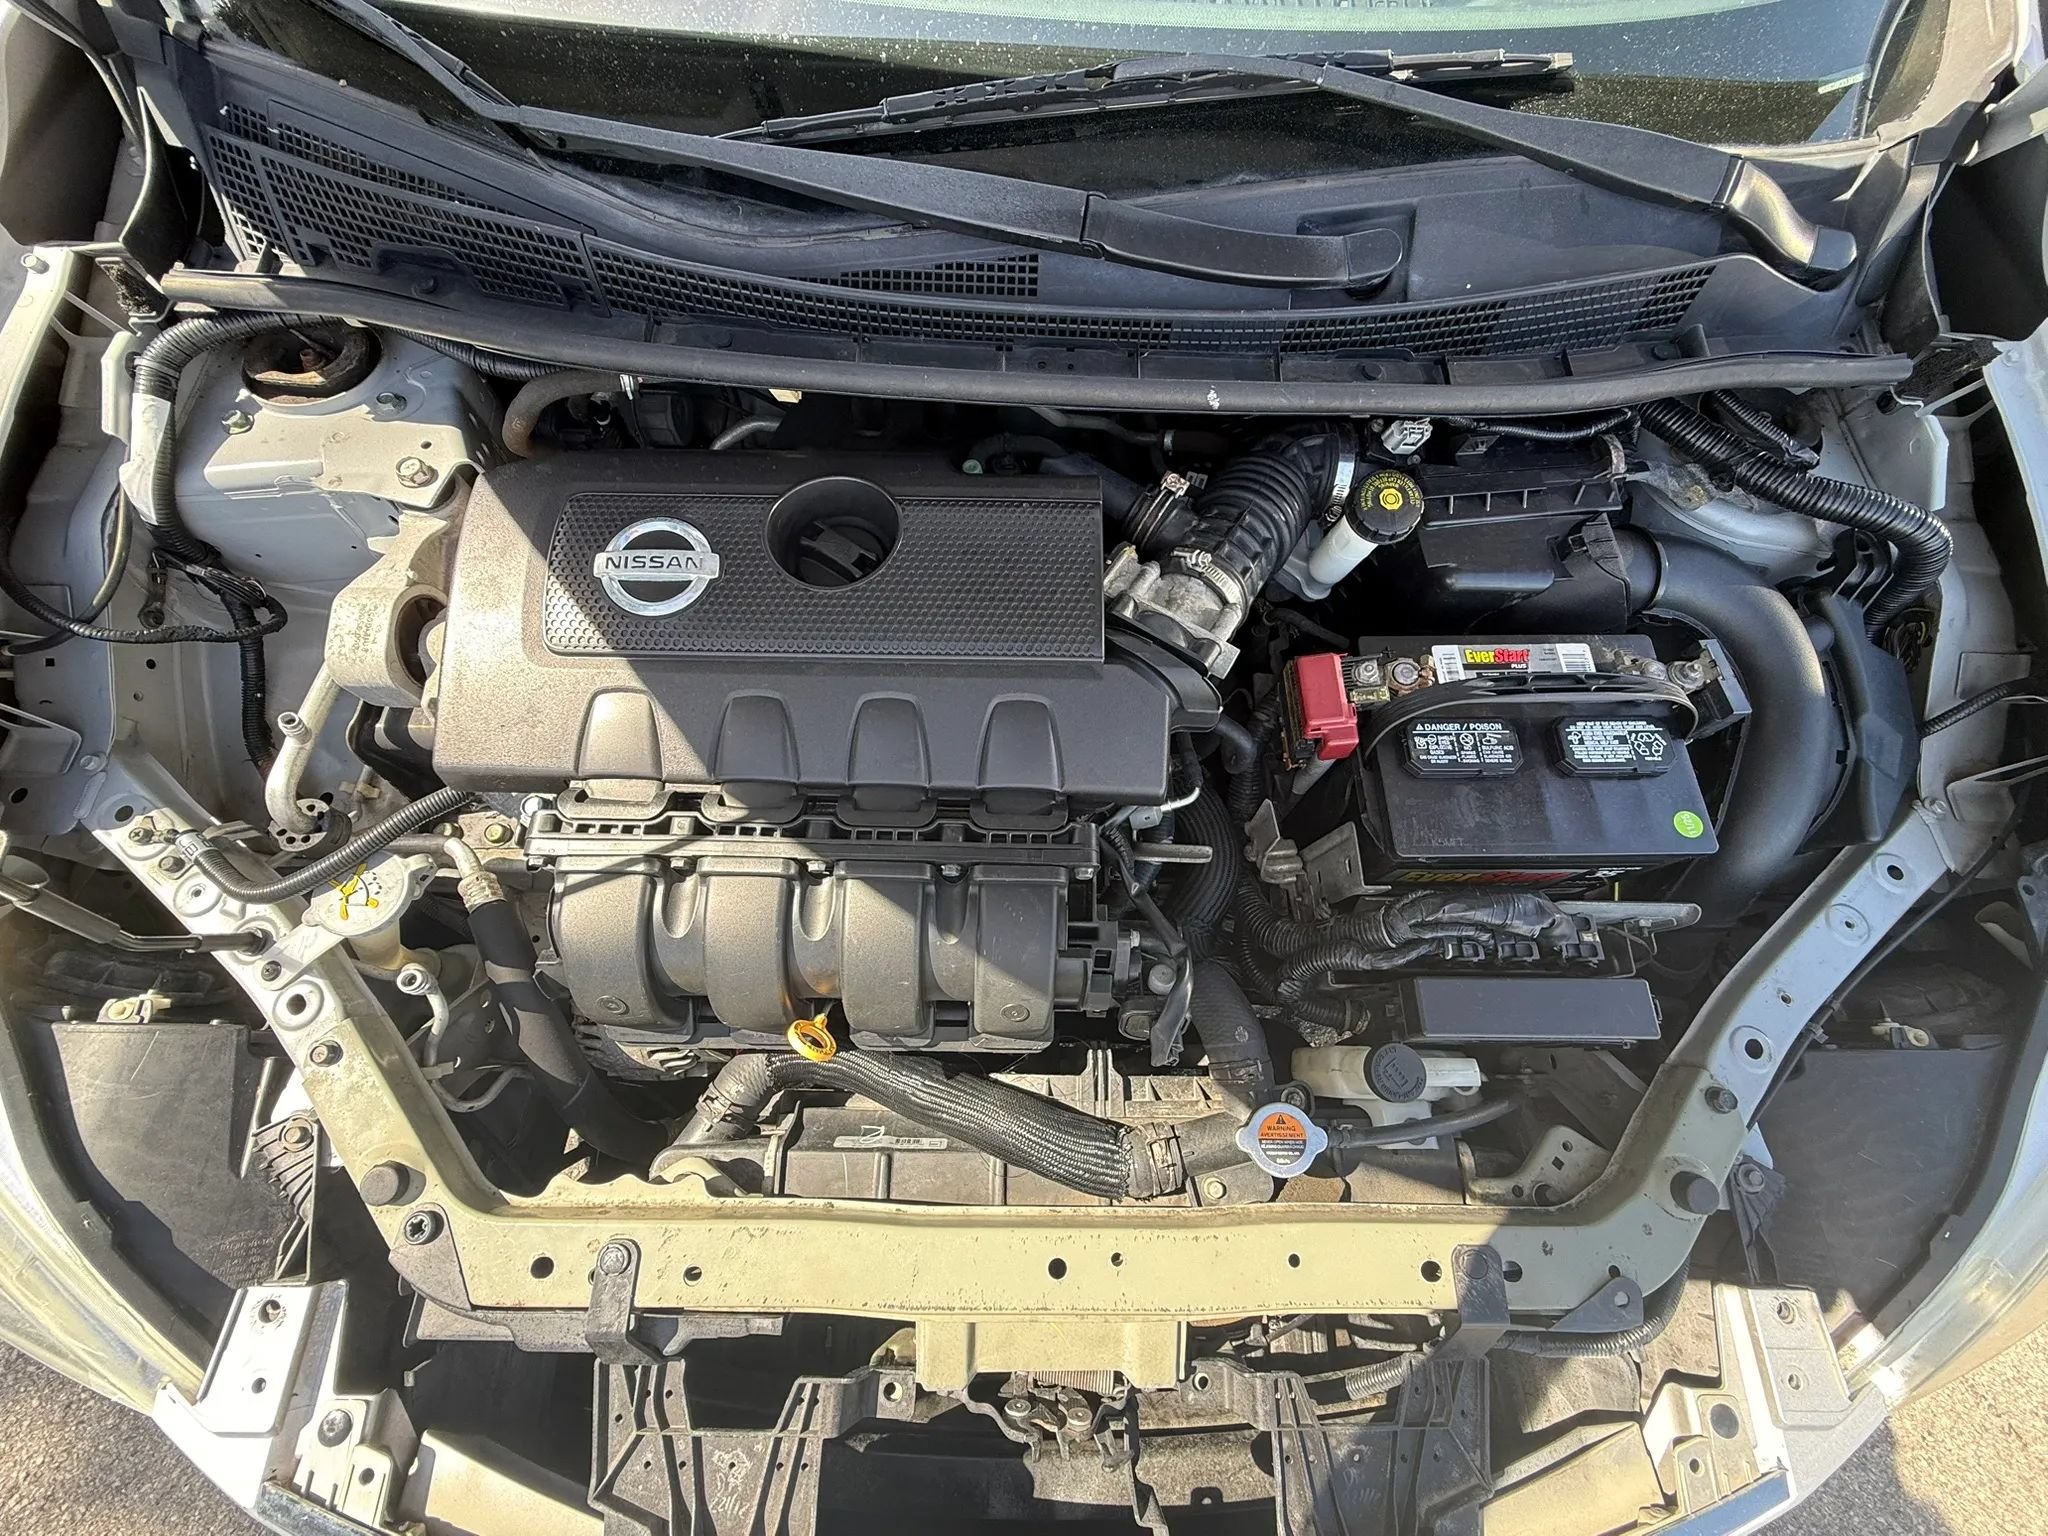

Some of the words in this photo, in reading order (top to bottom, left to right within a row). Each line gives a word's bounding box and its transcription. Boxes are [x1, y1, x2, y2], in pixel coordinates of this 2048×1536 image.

[605, 555, 704, 569] NISSAN
[1464, 648, 1530, 664] EverStart
[1424, 723, 1461, 731] DANGER
